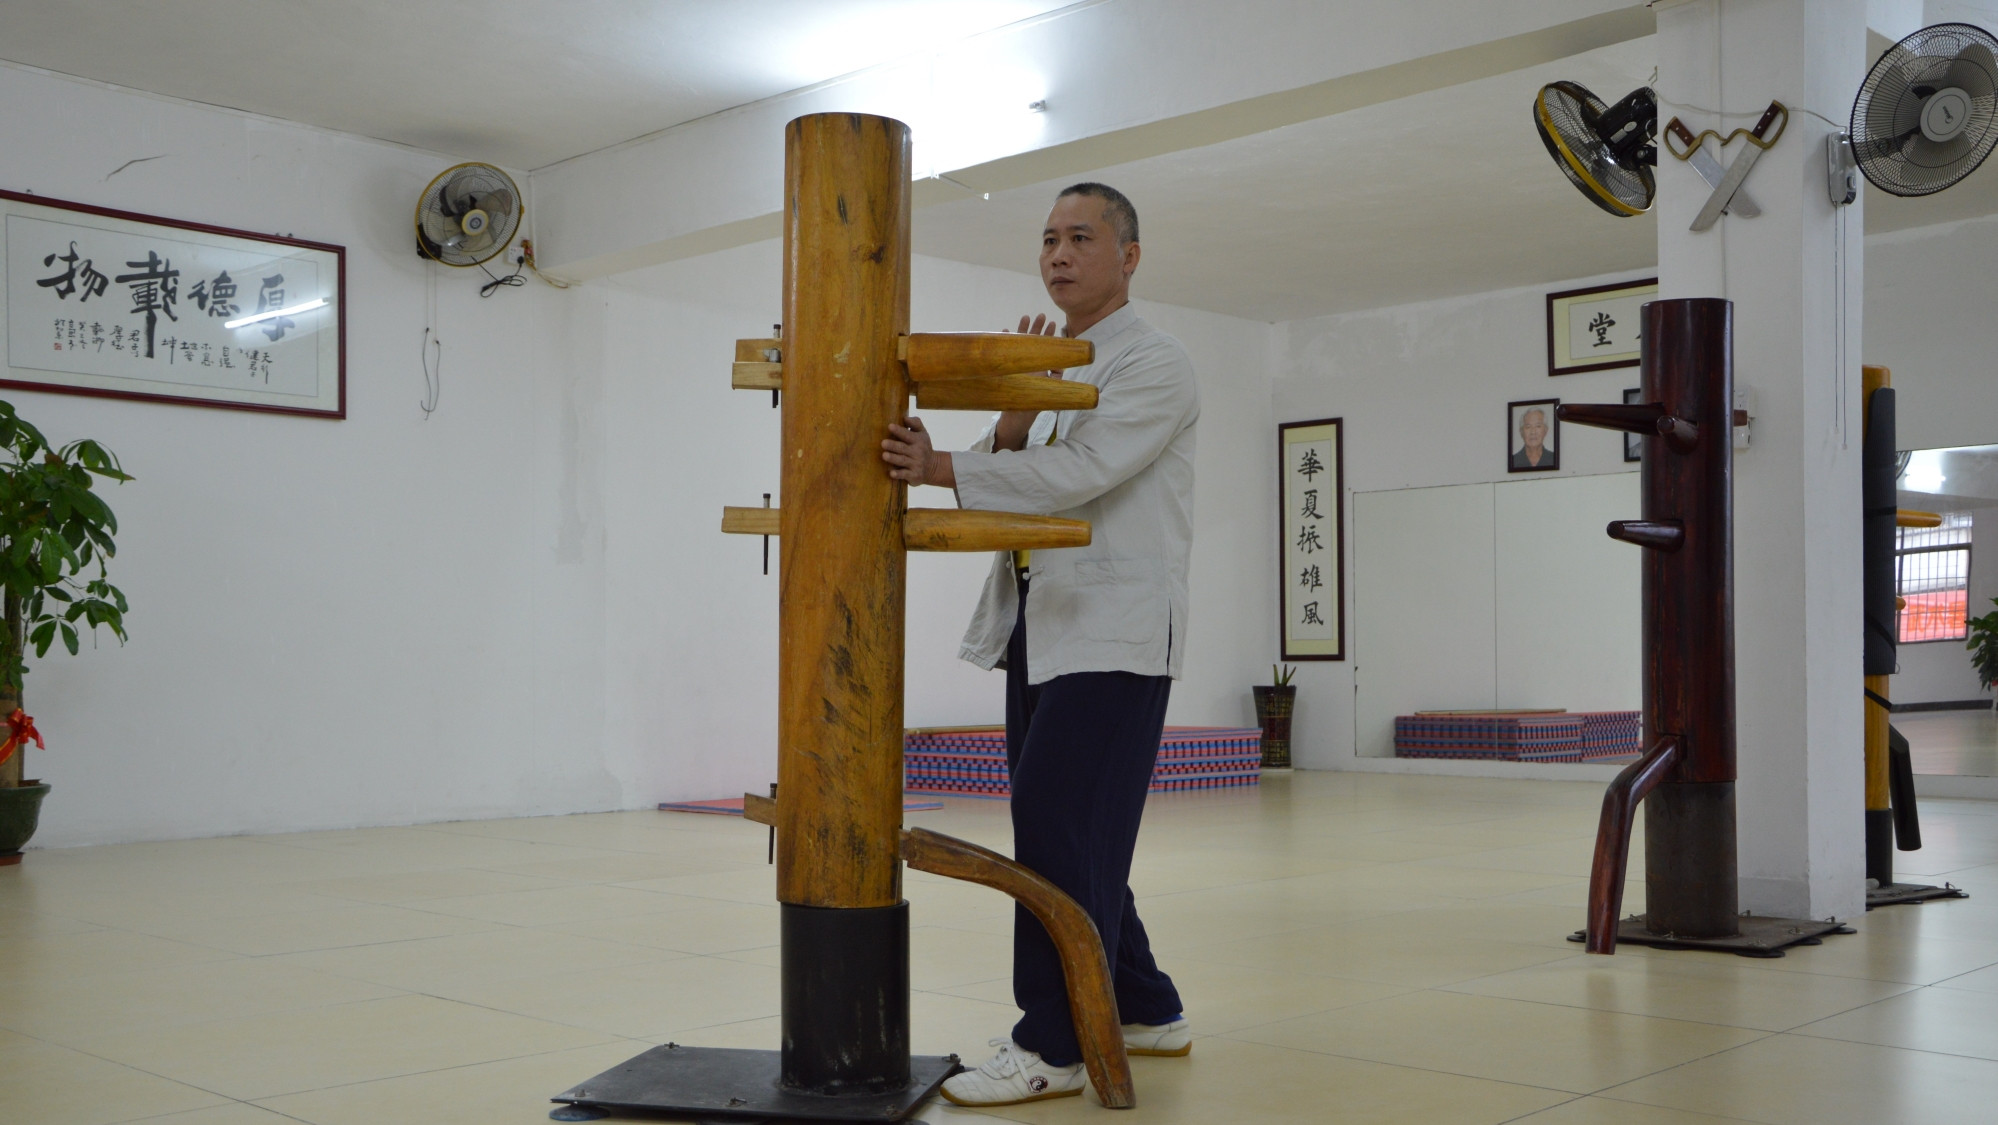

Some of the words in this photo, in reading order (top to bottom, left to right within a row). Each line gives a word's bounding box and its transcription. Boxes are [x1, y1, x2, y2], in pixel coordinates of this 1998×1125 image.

[1296, 447, 1325, 626] 華夏振雄風
